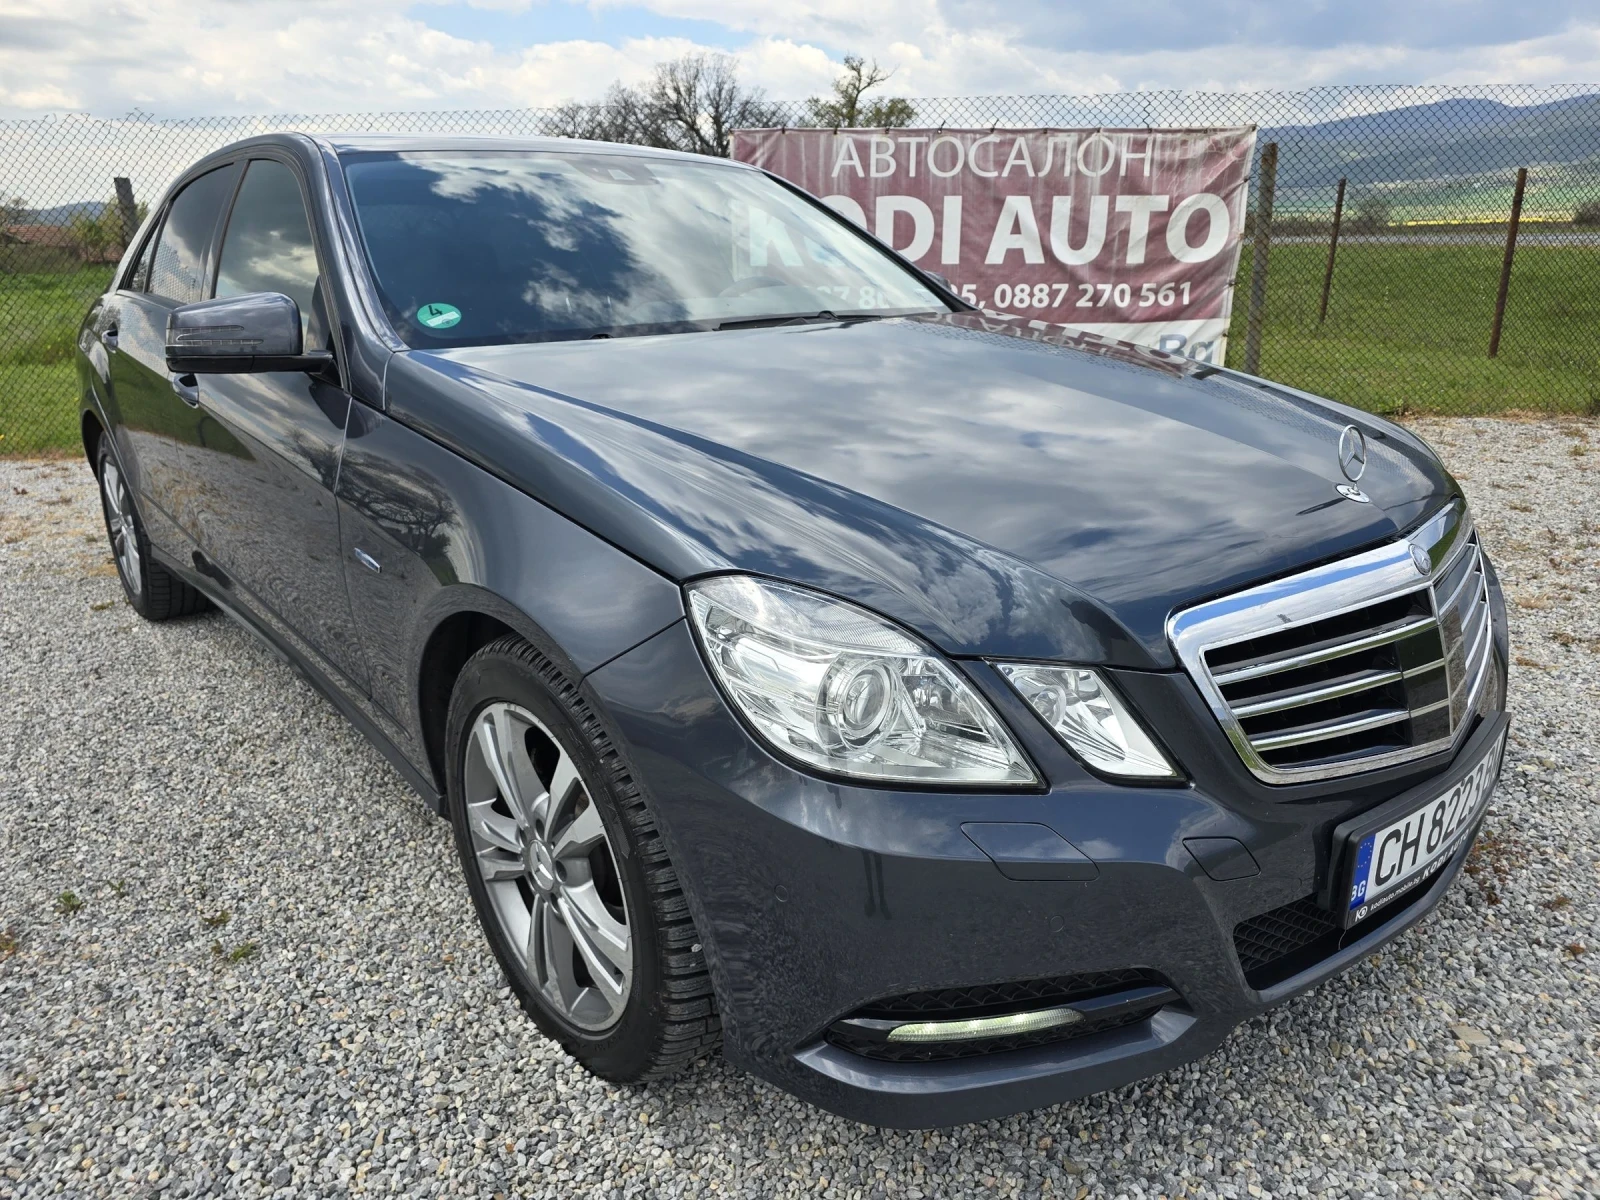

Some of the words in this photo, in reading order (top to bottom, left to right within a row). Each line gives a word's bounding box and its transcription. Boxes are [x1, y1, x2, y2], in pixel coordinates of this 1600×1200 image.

[831, 136, 1152, 179] АВТОСАЛОН
[985, 192, 1231, 266] AUTO
[994, 283, 1070, 308] 0887
[1080, 283, 1131, 308] 270
[1139, 282, 1192, 307] 561
[1374, 812, 1425, 887] CH
